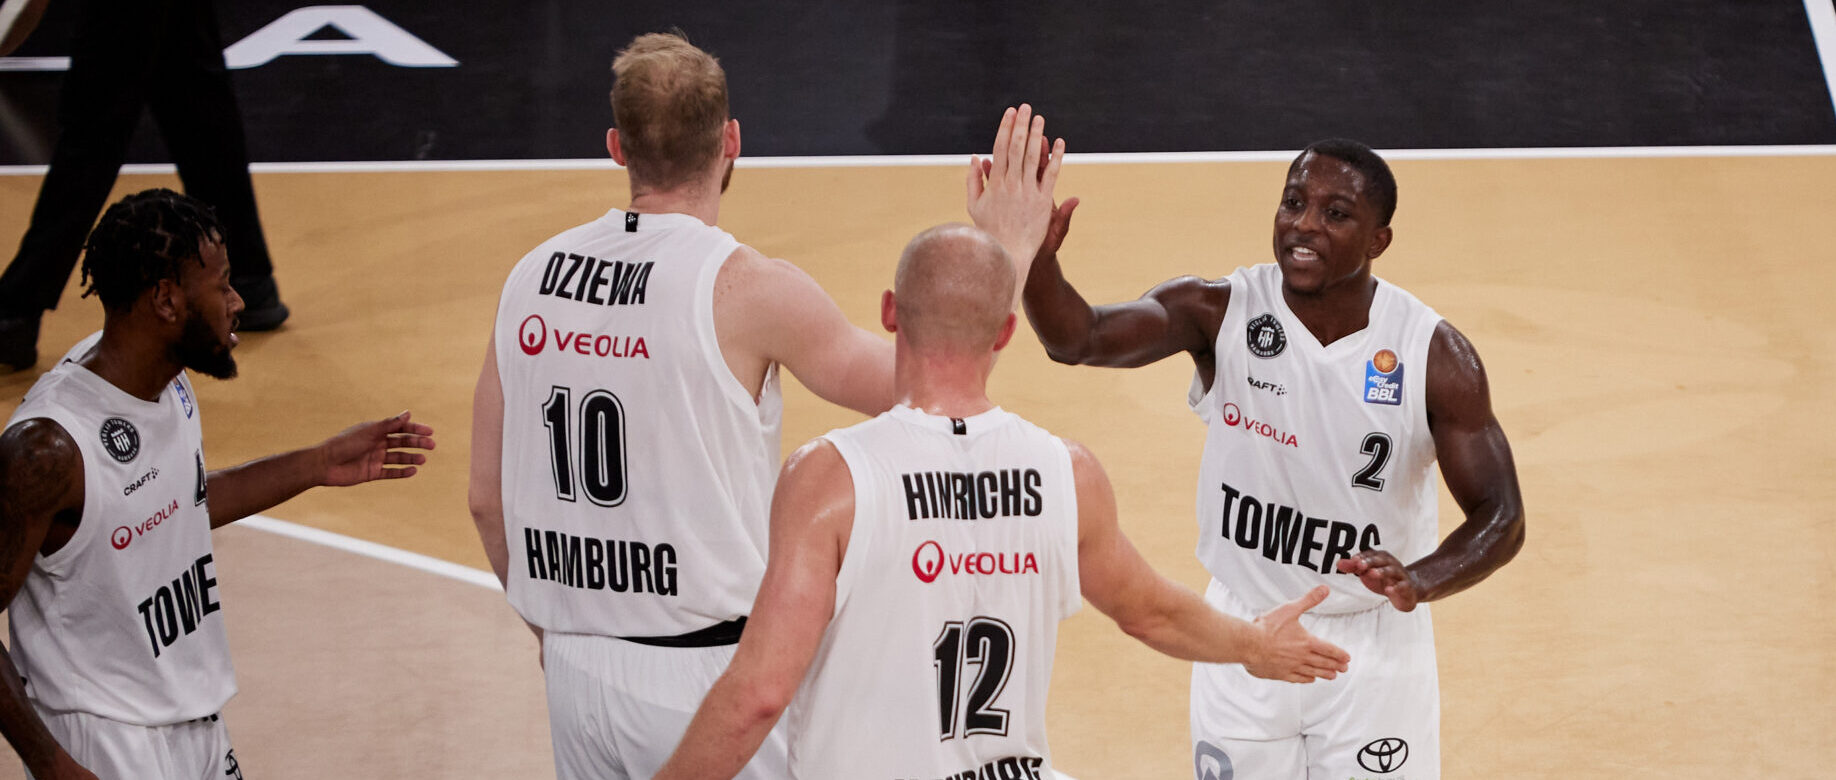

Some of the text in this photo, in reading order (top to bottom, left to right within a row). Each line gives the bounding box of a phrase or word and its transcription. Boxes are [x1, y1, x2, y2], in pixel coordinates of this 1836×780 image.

[539, 251, 655, 306] DZIEWA
[553, 328, 650, 359] VEOLIA
[1247, 377, 1277, 392] RAFT
[1367, 387, 1398, 402] BBL
[542, 385, 628, 508] 10
[1244, 416, 1298, 448] VEOLIA
[1351, 432, 1393, 491] 2
[124, 472, 151, 496] CRAFT
[902, 468, 1043, 521] HINRICHS
[135, 499, 179, 536] VEOLIA
[524, 527, 678, 597] HAMBURG
[949, 552, 1039, 575] VEOLIA
[933, 616, 1016, 742] 12
